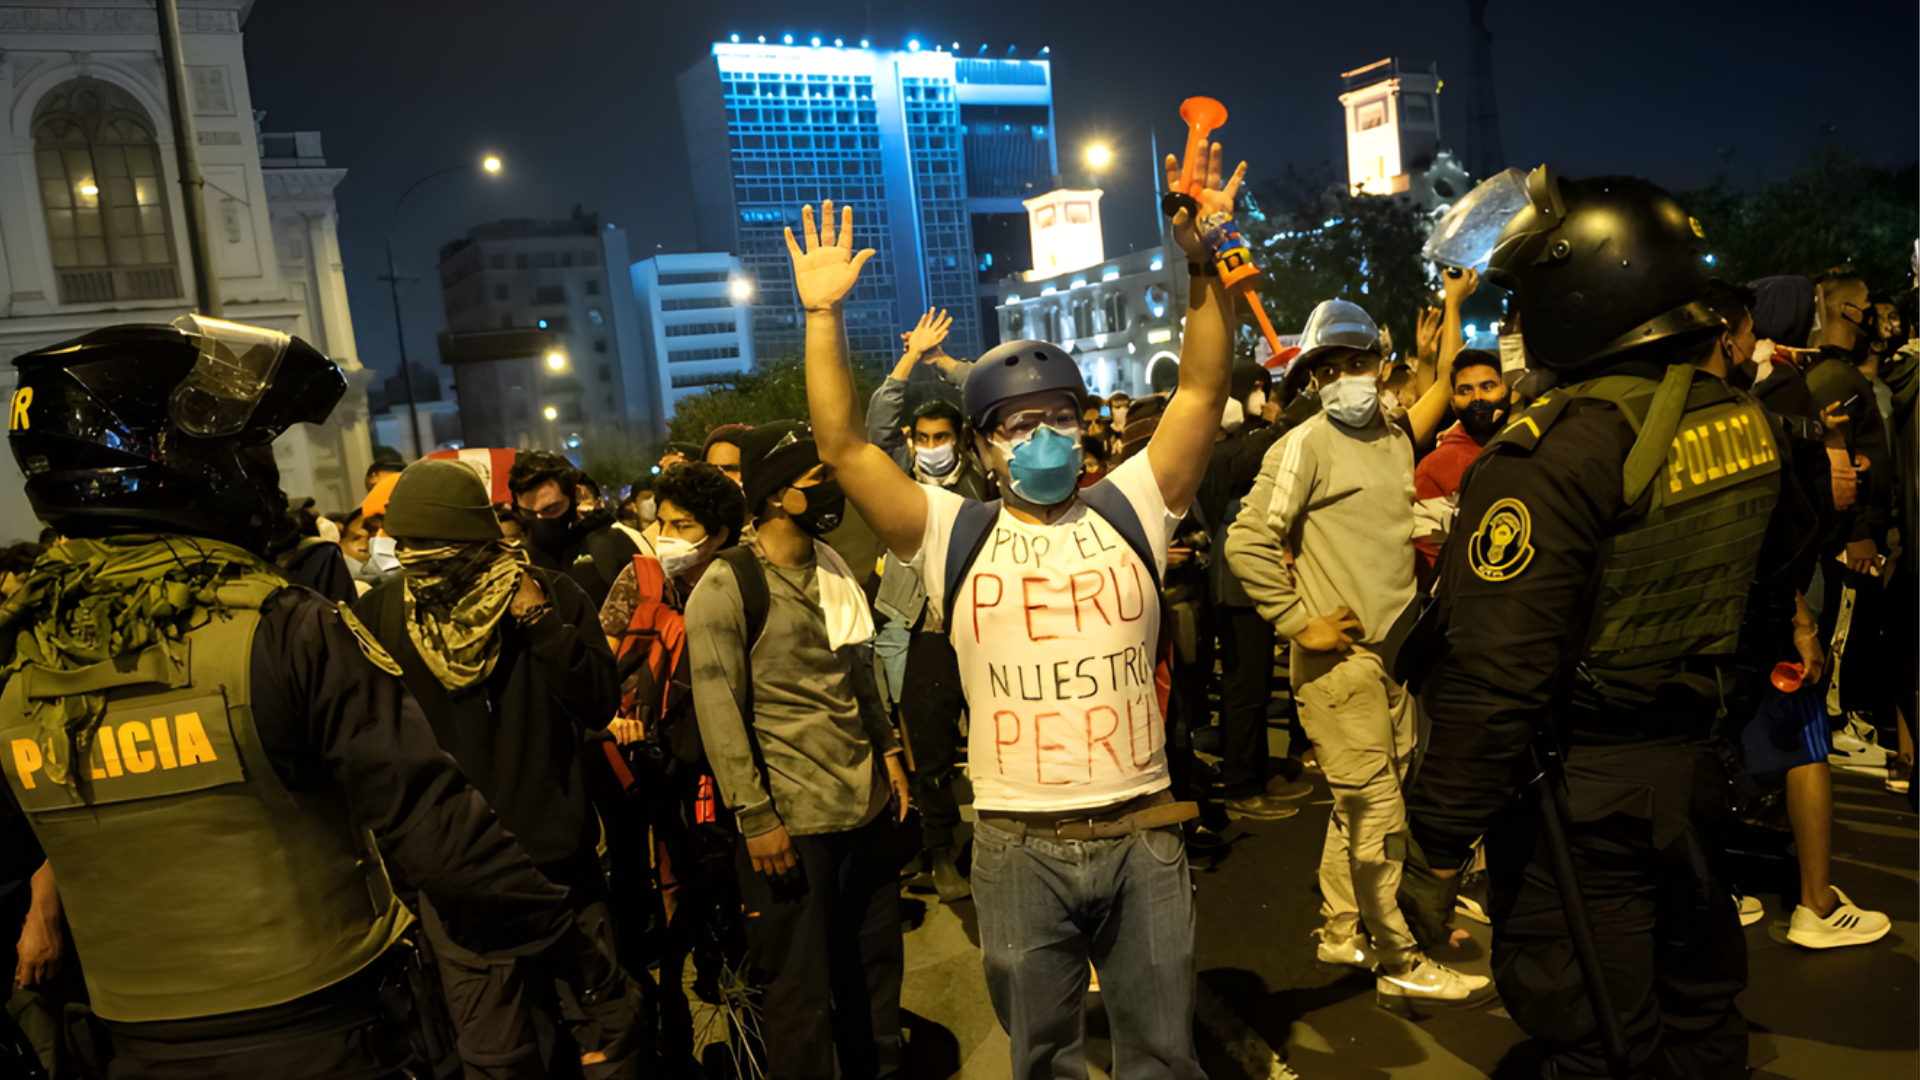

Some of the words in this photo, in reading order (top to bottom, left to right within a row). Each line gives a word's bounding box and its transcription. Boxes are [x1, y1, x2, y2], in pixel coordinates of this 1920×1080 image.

[1073, 521, 1116, 559] EL
[988, 641, 1149, 701] NUESTRO
[11, 711, 218, 790] PLICIA
[993, 693, 1153, 785] PERÚ
